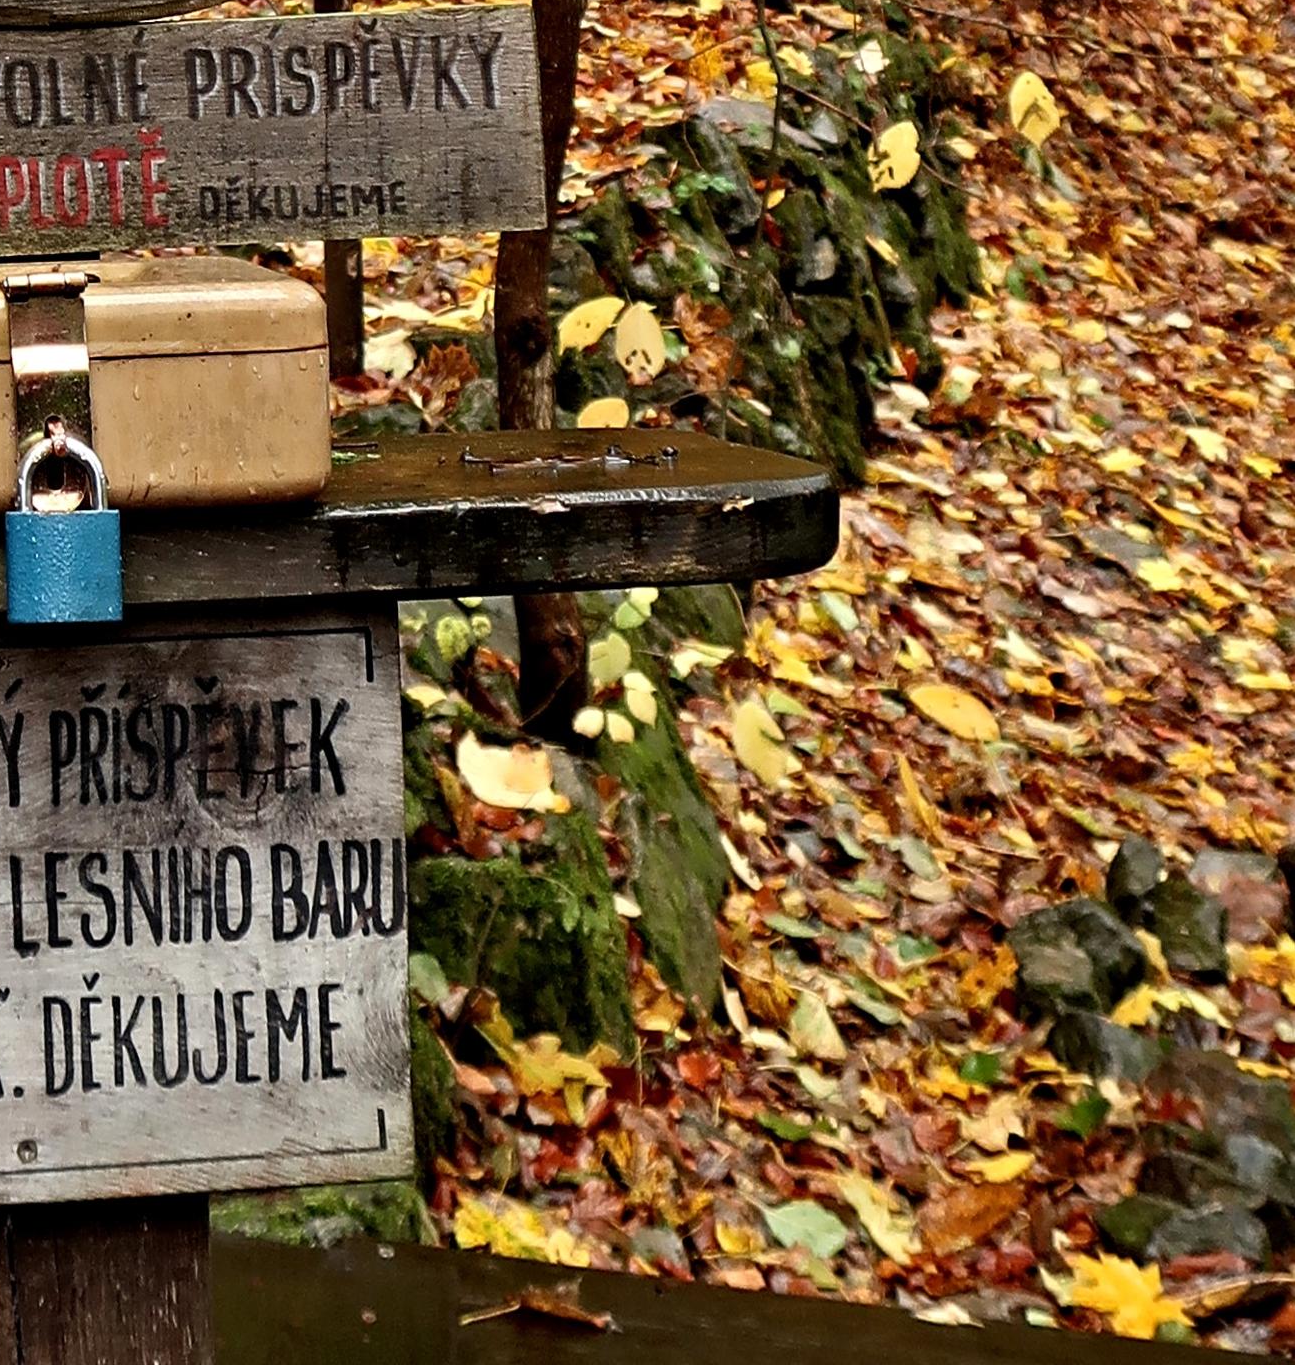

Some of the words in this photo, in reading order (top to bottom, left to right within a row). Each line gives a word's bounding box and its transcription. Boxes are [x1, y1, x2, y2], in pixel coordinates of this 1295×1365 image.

[199, 175, 407, 222] DĚKUJEME
[49, 675, 350, 807] PŘÍSPĚVEK
[9, 844, 253, 957] LESNIHO
[270, 837, 405, 940] BARU
[43, 972, 348, 1096] DĚKUJEME
